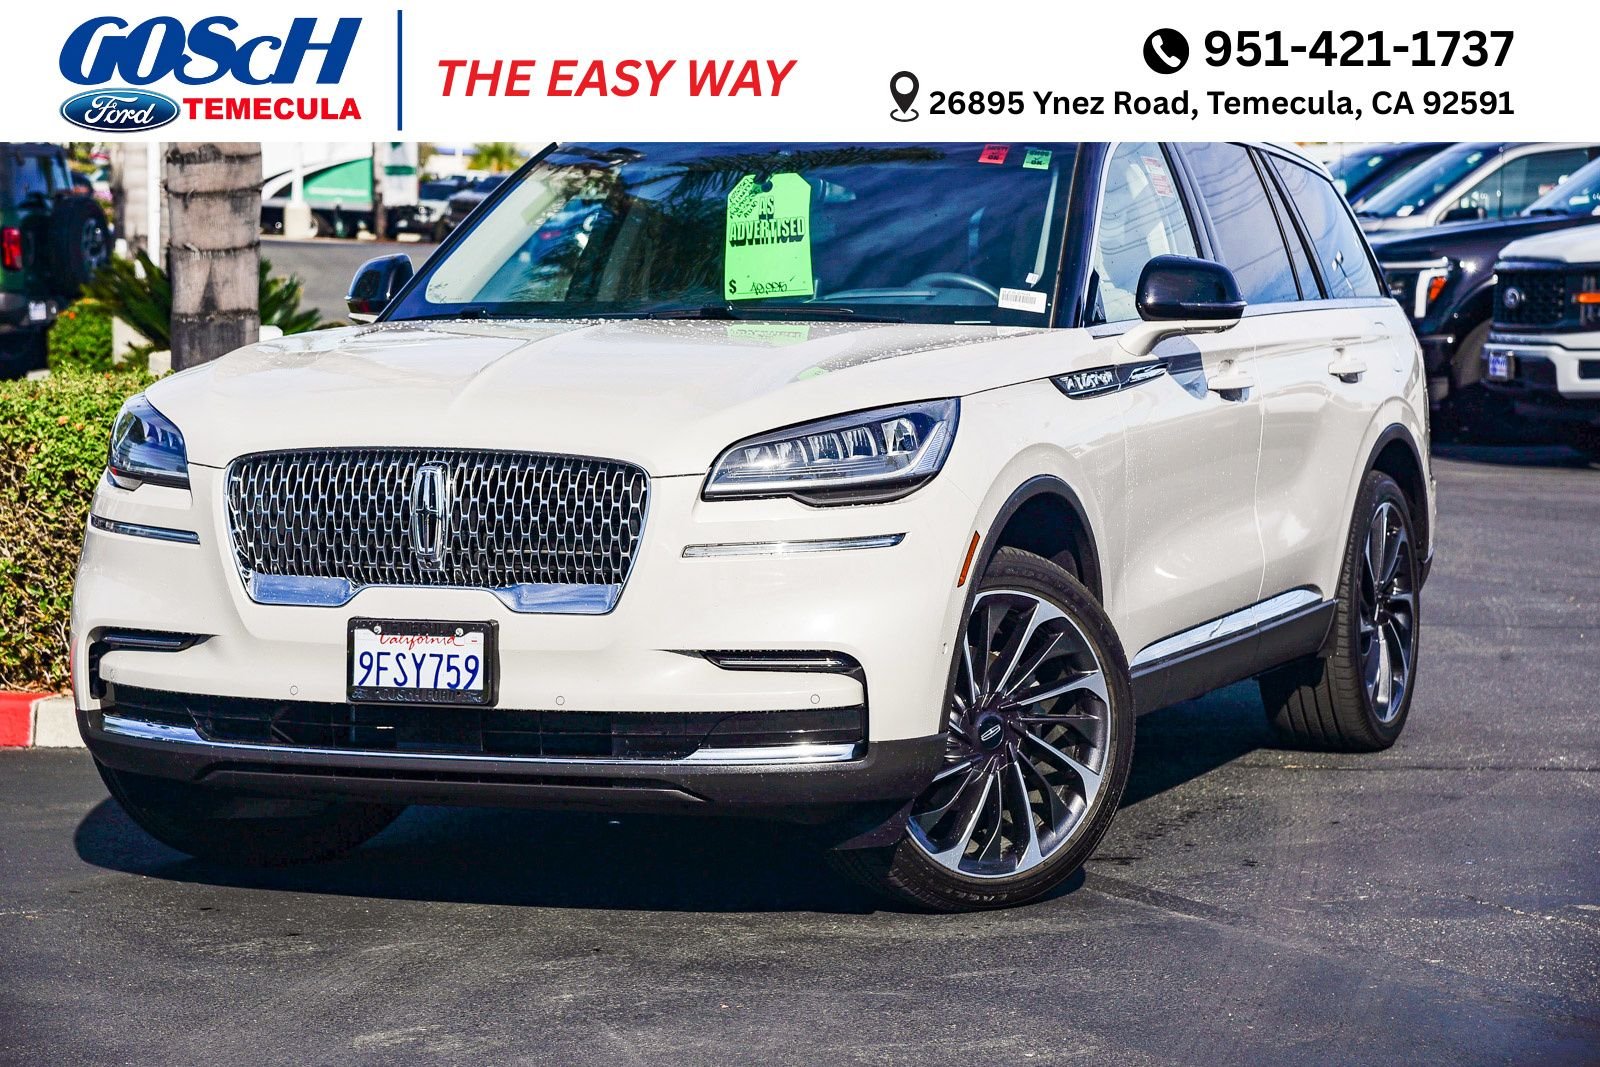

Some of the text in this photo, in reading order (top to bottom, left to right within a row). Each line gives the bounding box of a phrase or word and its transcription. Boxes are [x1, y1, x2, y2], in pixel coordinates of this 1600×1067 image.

[758, 196, 775, 220] AS
[729, 217, 805, 247] ADVERTISED
[728, 279, 737, 294] $
[380, 634, 465, 650] California
[358, 651, 480, 690] 9FSY759
